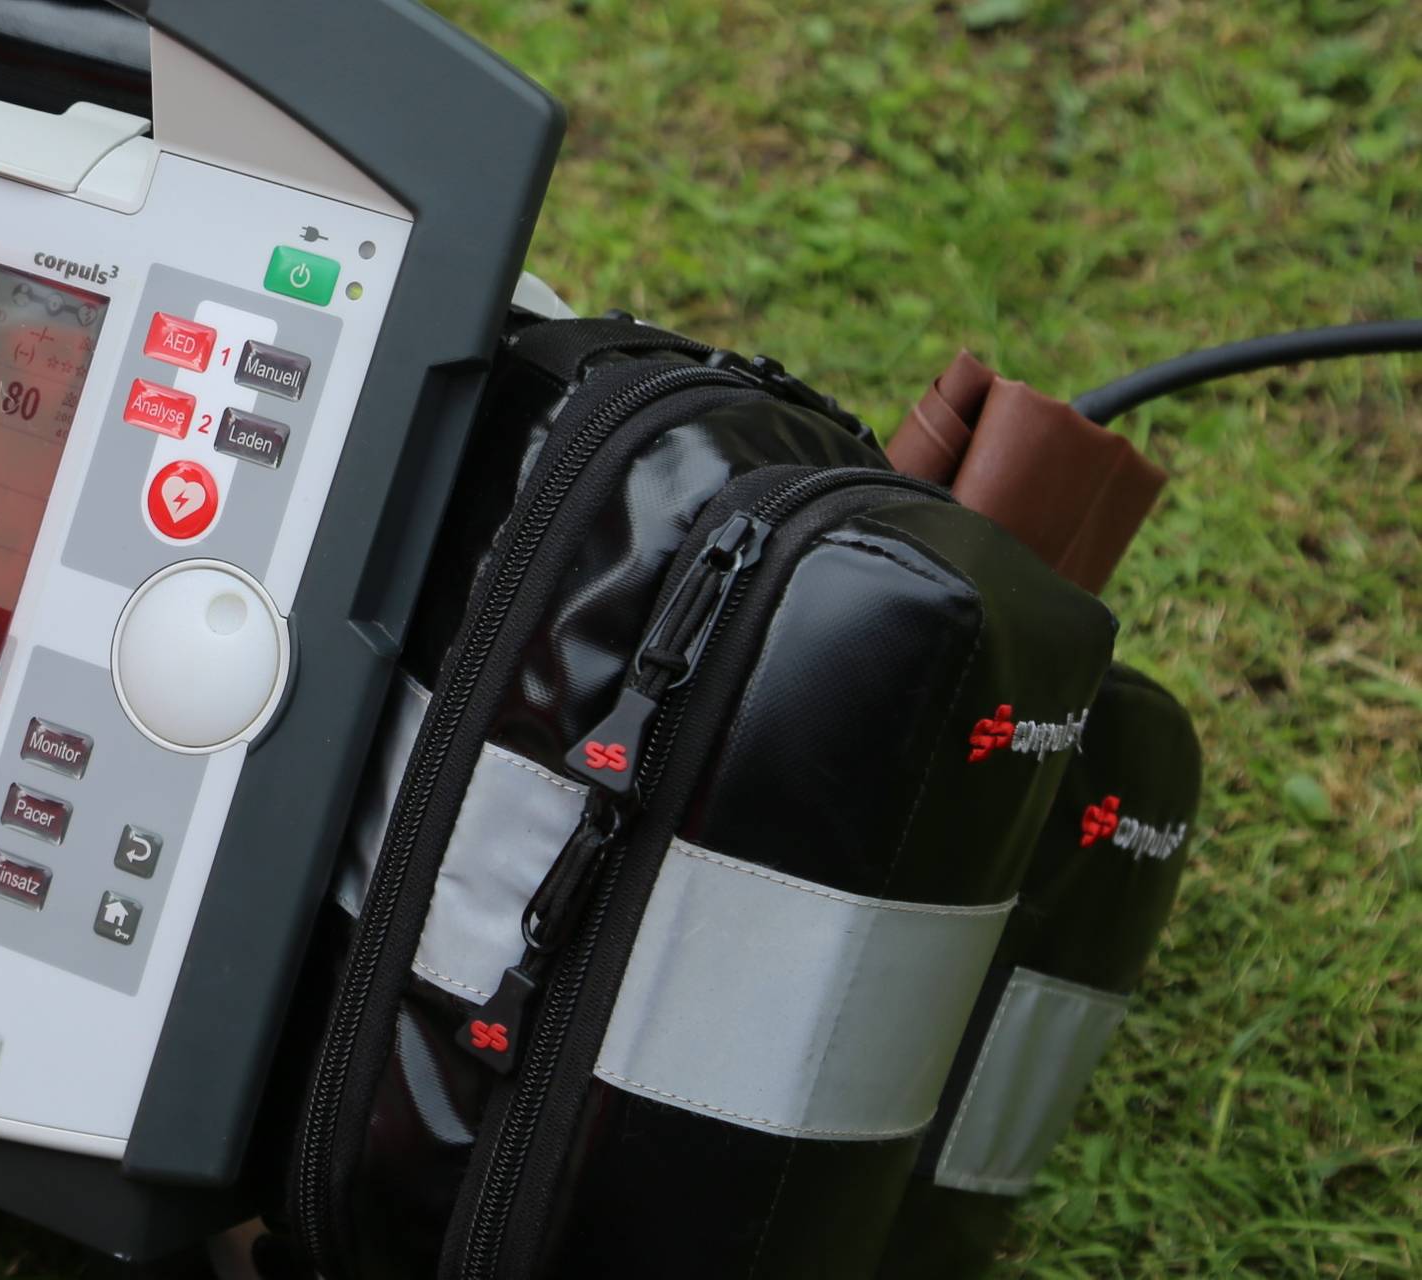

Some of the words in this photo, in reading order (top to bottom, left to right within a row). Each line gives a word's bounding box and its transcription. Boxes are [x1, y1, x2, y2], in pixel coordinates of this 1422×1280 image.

[163, 331, 196, 354] AED
[220, 347, 232, 366] 1
[244, 356, 301, 388] Manuell
[2, 381, 42, 421] 80
[131, 394, 185, 425] Analyse
[198, 414, 213, 434] 2
[228, 425, 273, 454] Laden
[29, 732, 81, 764] Monitor
[14, 799, 56, 827] Pacer
